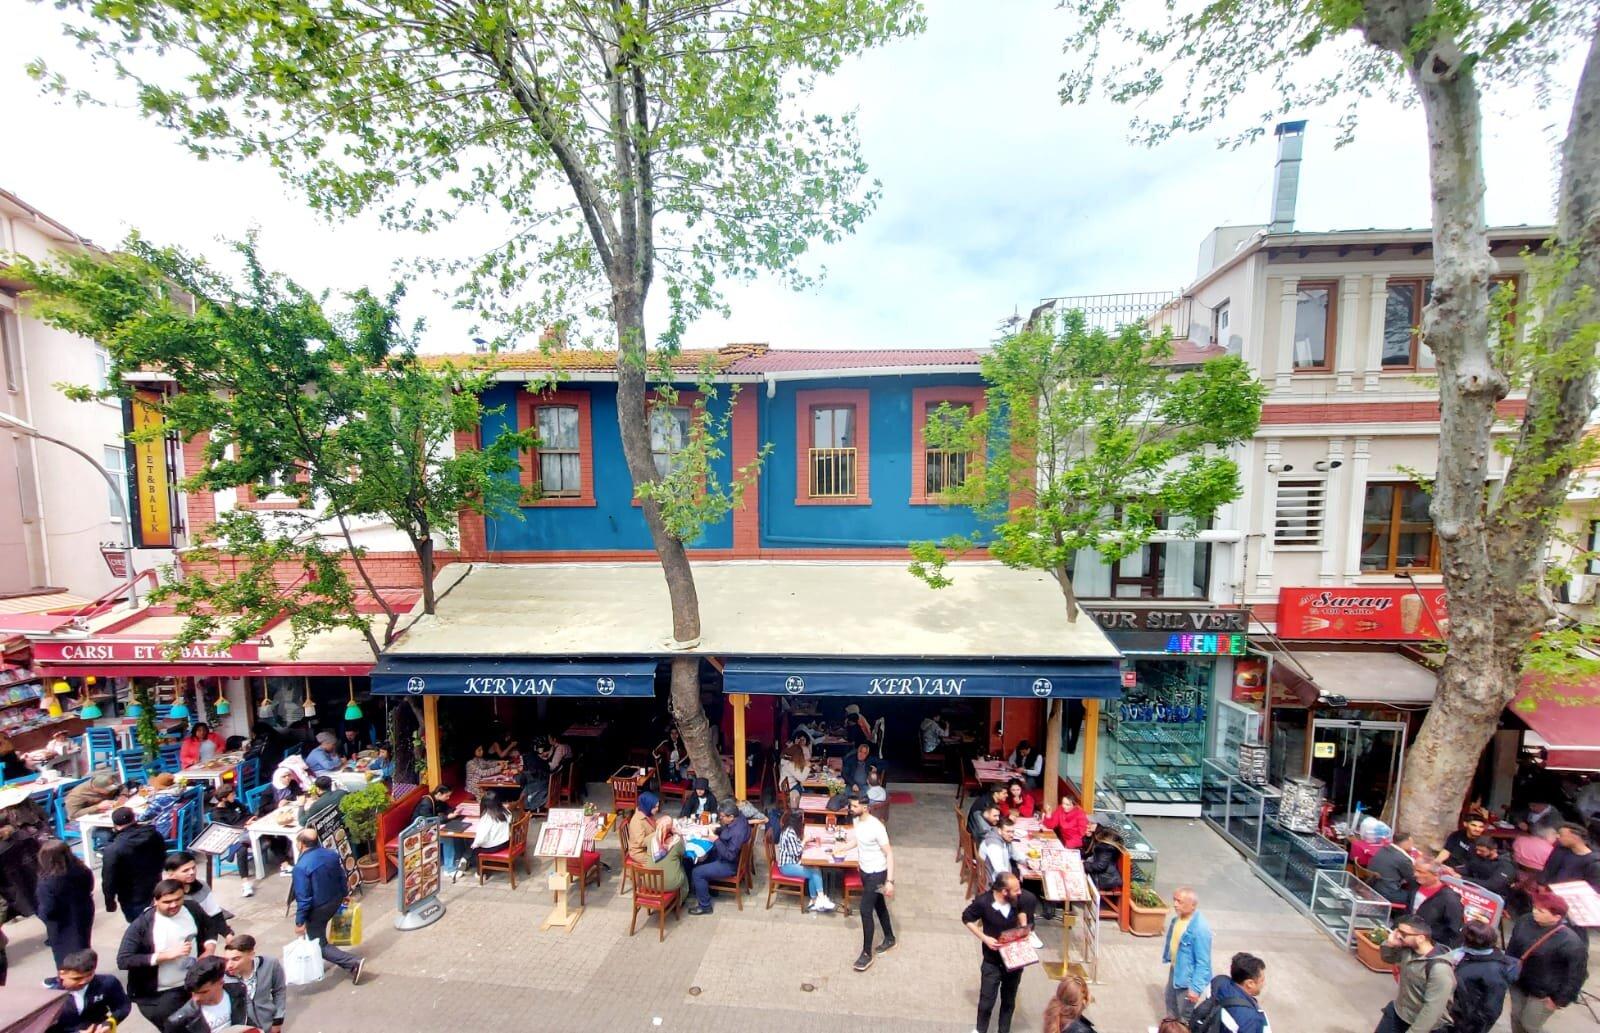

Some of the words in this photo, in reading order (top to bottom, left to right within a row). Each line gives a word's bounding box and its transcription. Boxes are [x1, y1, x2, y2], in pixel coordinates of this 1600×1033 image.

[1312, 592, 1393, 611] Saray
[1146, 611, 1244, 630] SILVER
[61, 645, 114, 660] ÇARŞI
[134, 646, 155, 658] ET
[463, 677, 556, 695] KERVAN
[867, 676, 966, 695] KERVAN
